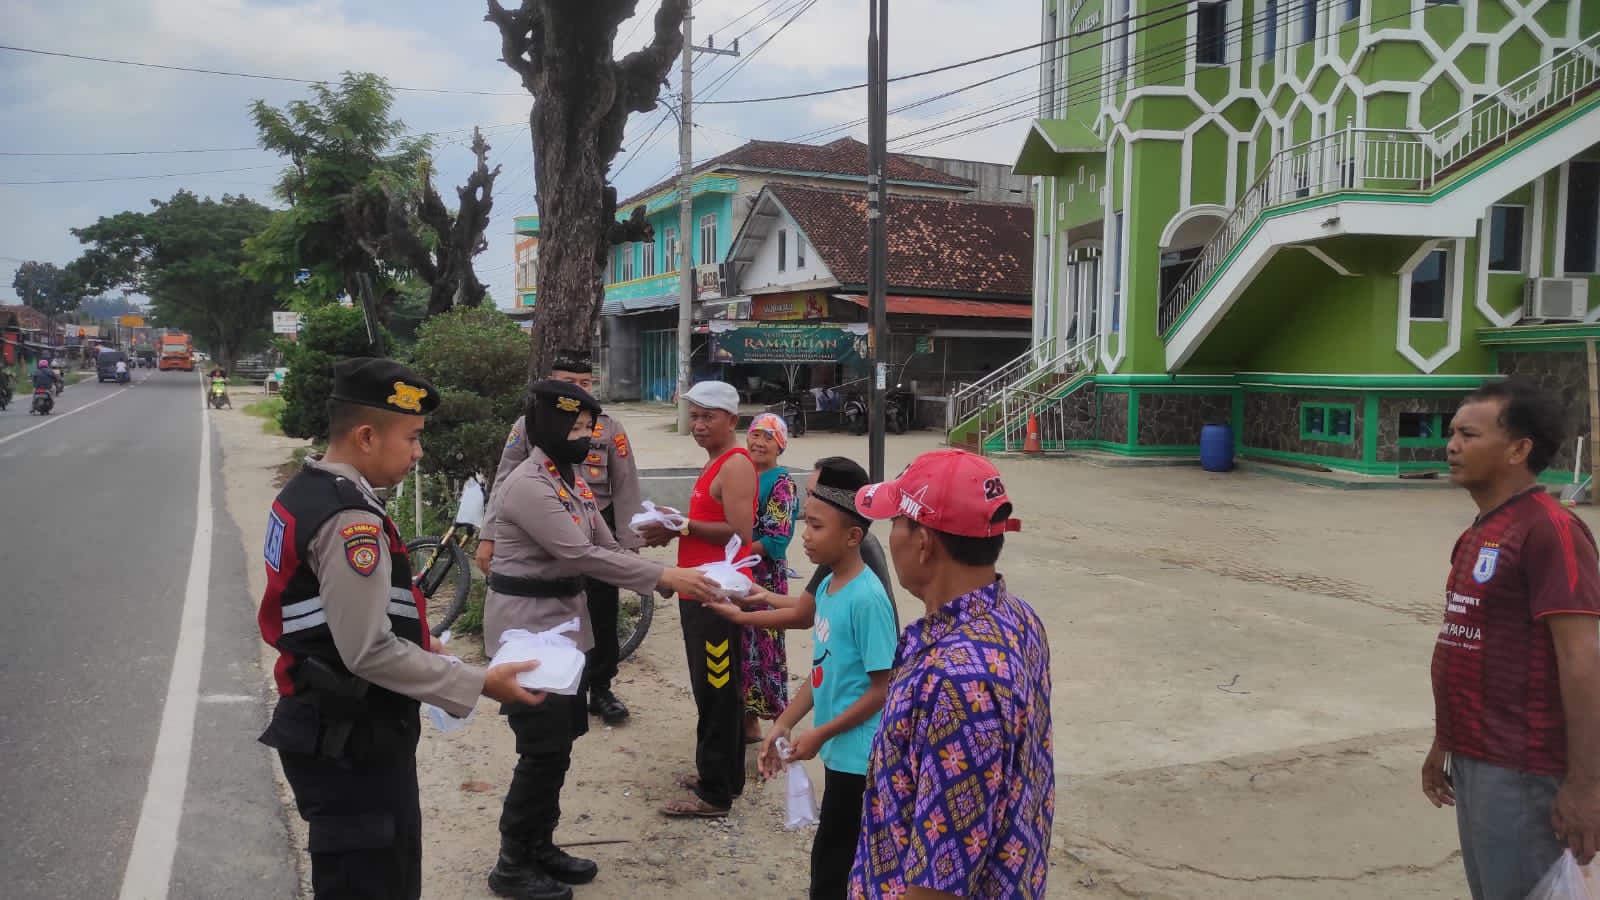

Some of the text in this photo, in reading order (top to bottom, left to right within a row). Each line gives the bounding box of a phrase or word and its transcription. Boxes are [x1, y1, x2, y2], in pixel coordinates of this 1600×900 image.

[743, 337, 838, 350] RAMADHAN
[985, 477, 1005, 500] 25
[1449, 623, 1481, 640] PAPUA
